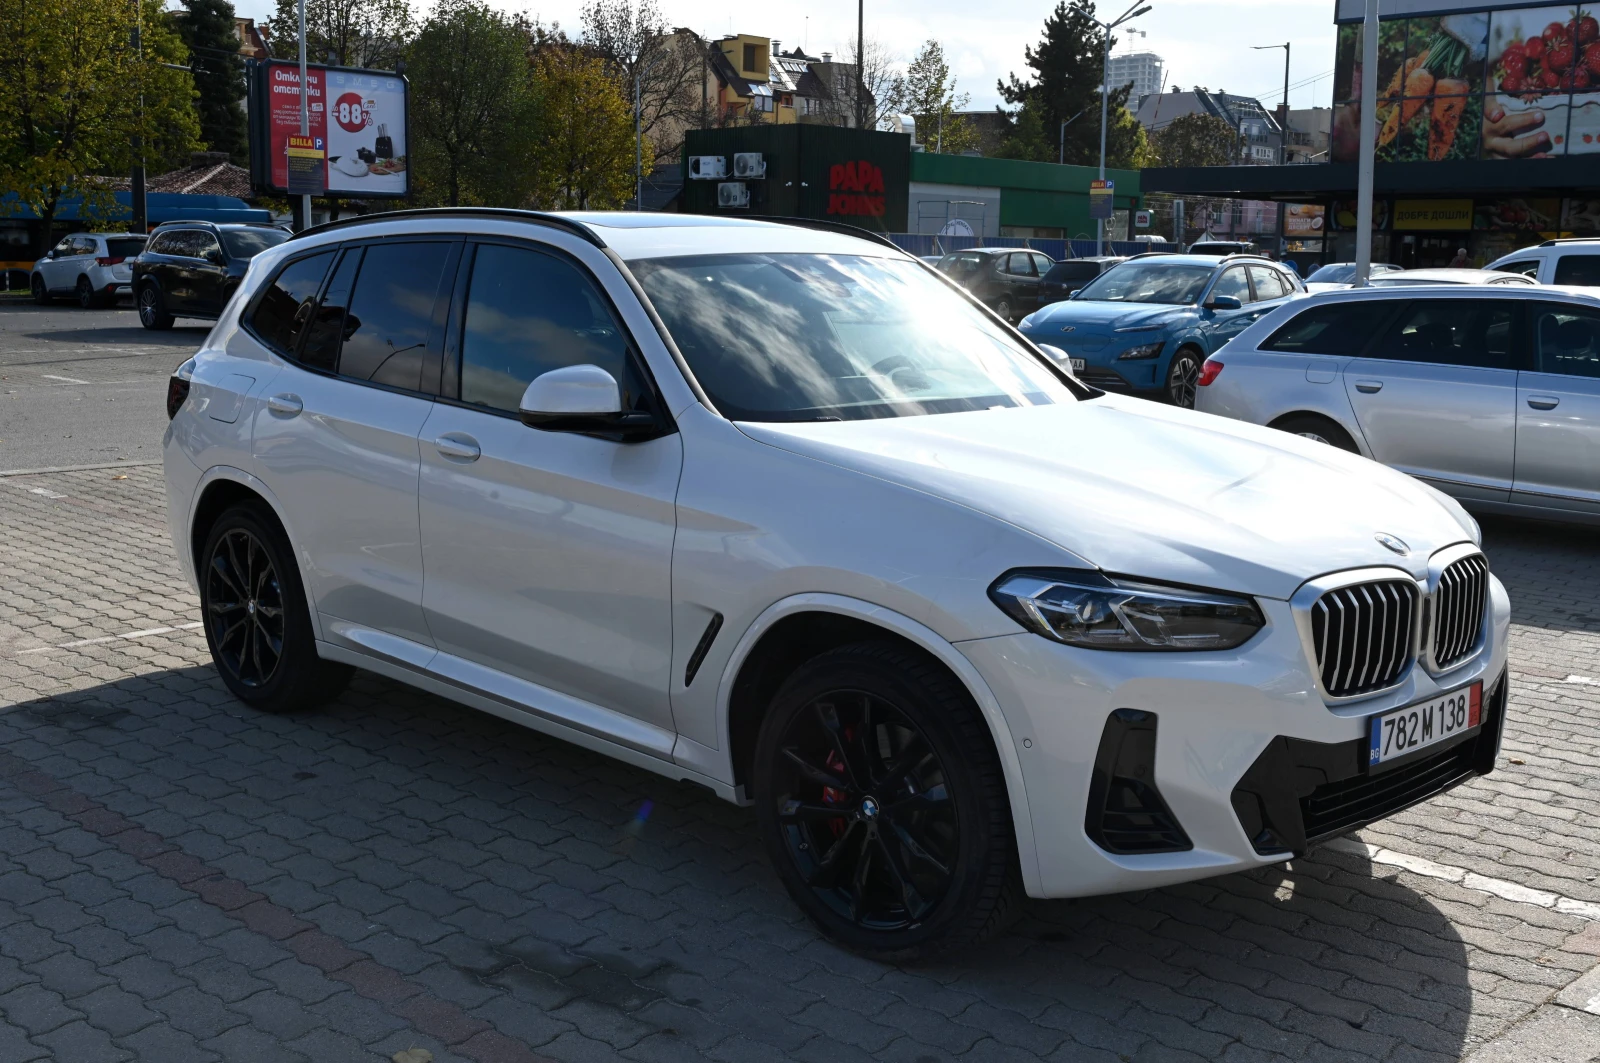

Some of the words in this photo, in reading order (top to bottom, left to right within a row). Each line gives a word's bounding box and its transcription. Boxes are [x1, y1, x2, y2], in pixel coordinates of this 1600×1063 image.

[275, 70, 318, 84] Отклчи
[273, 85, 321, 97] отстпки
[290, 137, 313, 147] BILLA
[316, 138, 322, 149] P
[829, 160, 885, 194] PAPA
[827, 193, 886, 217] JOHNS
[1396, 210, 1429, 222] ДОБРЕ
[1430, 210, 1469, 221] ДОШЛИ
[1383, 711, 1419, 757] 782
[1421, 705, 1434, 742] M
[1438, 694, 1466, 736] 138
[1370, 747, 1380, 761] BG
